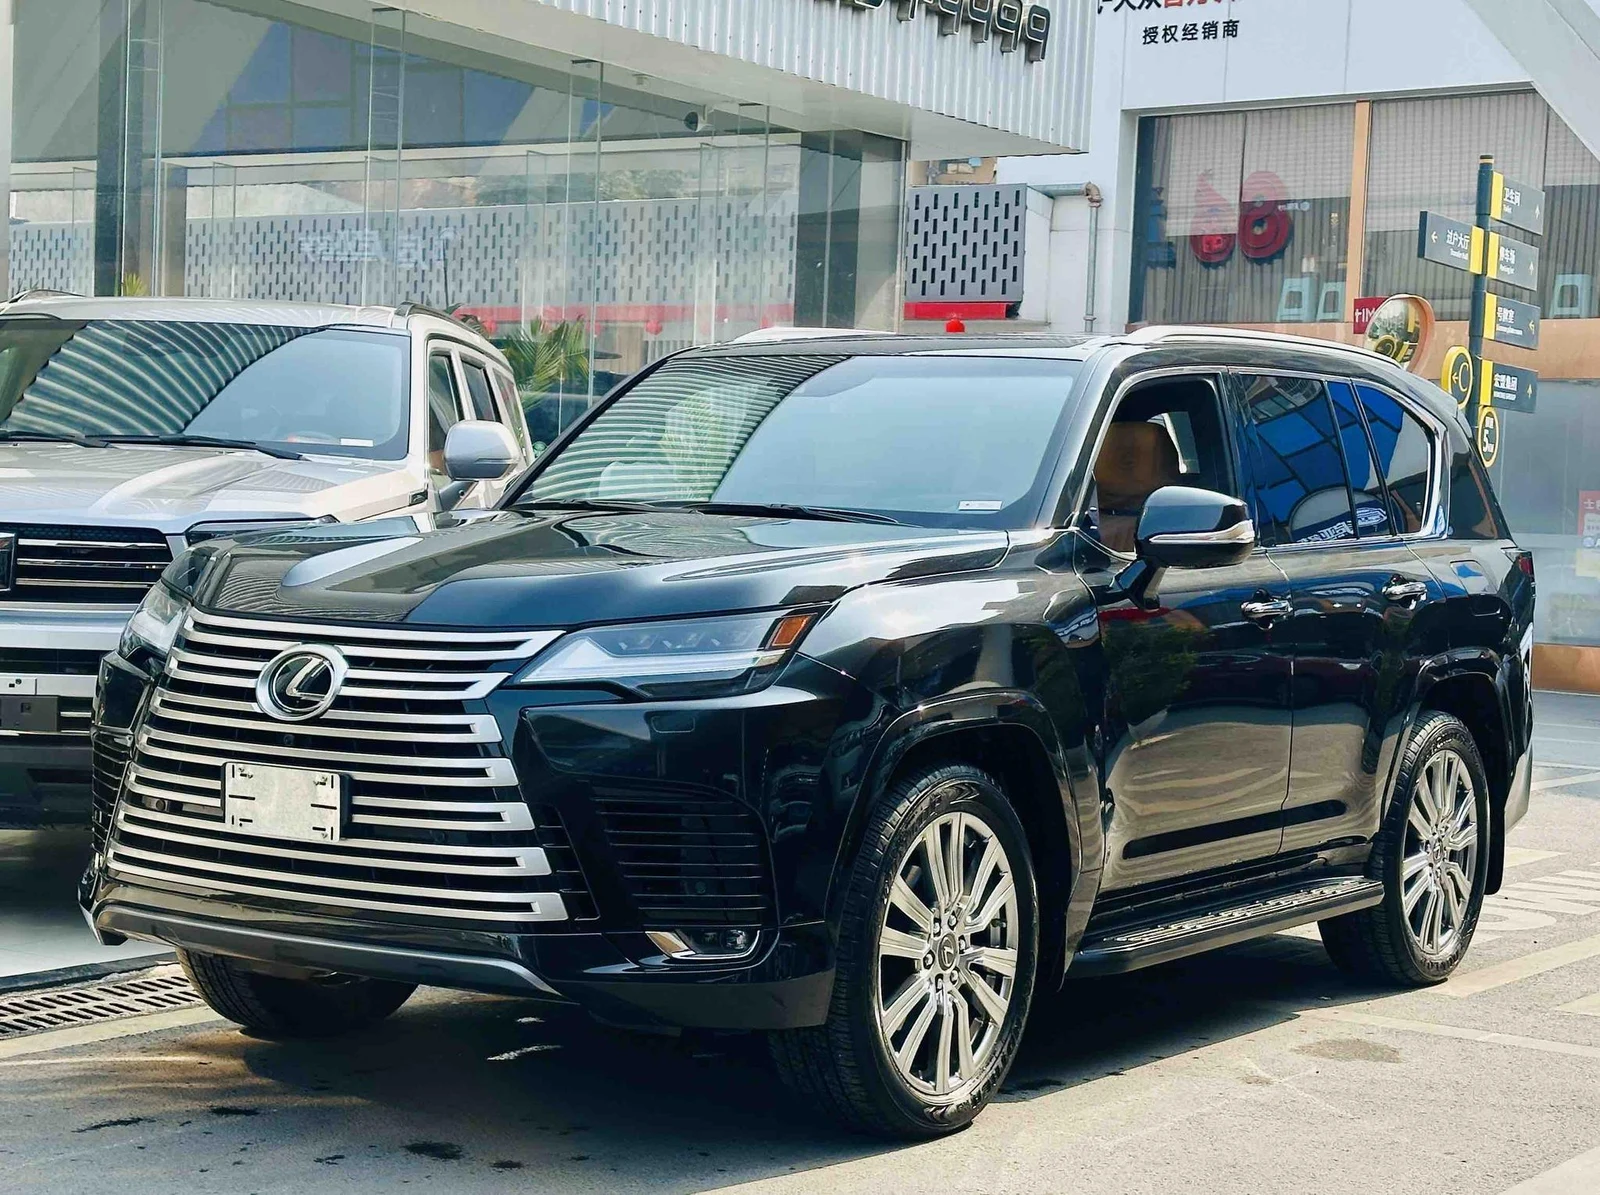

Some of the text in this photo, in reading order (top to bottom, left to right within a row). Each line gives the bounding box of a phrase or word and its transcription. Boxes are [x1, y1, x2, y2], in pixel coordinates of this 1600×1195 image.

[1142, 19, 1240, 45] 授权经销商
